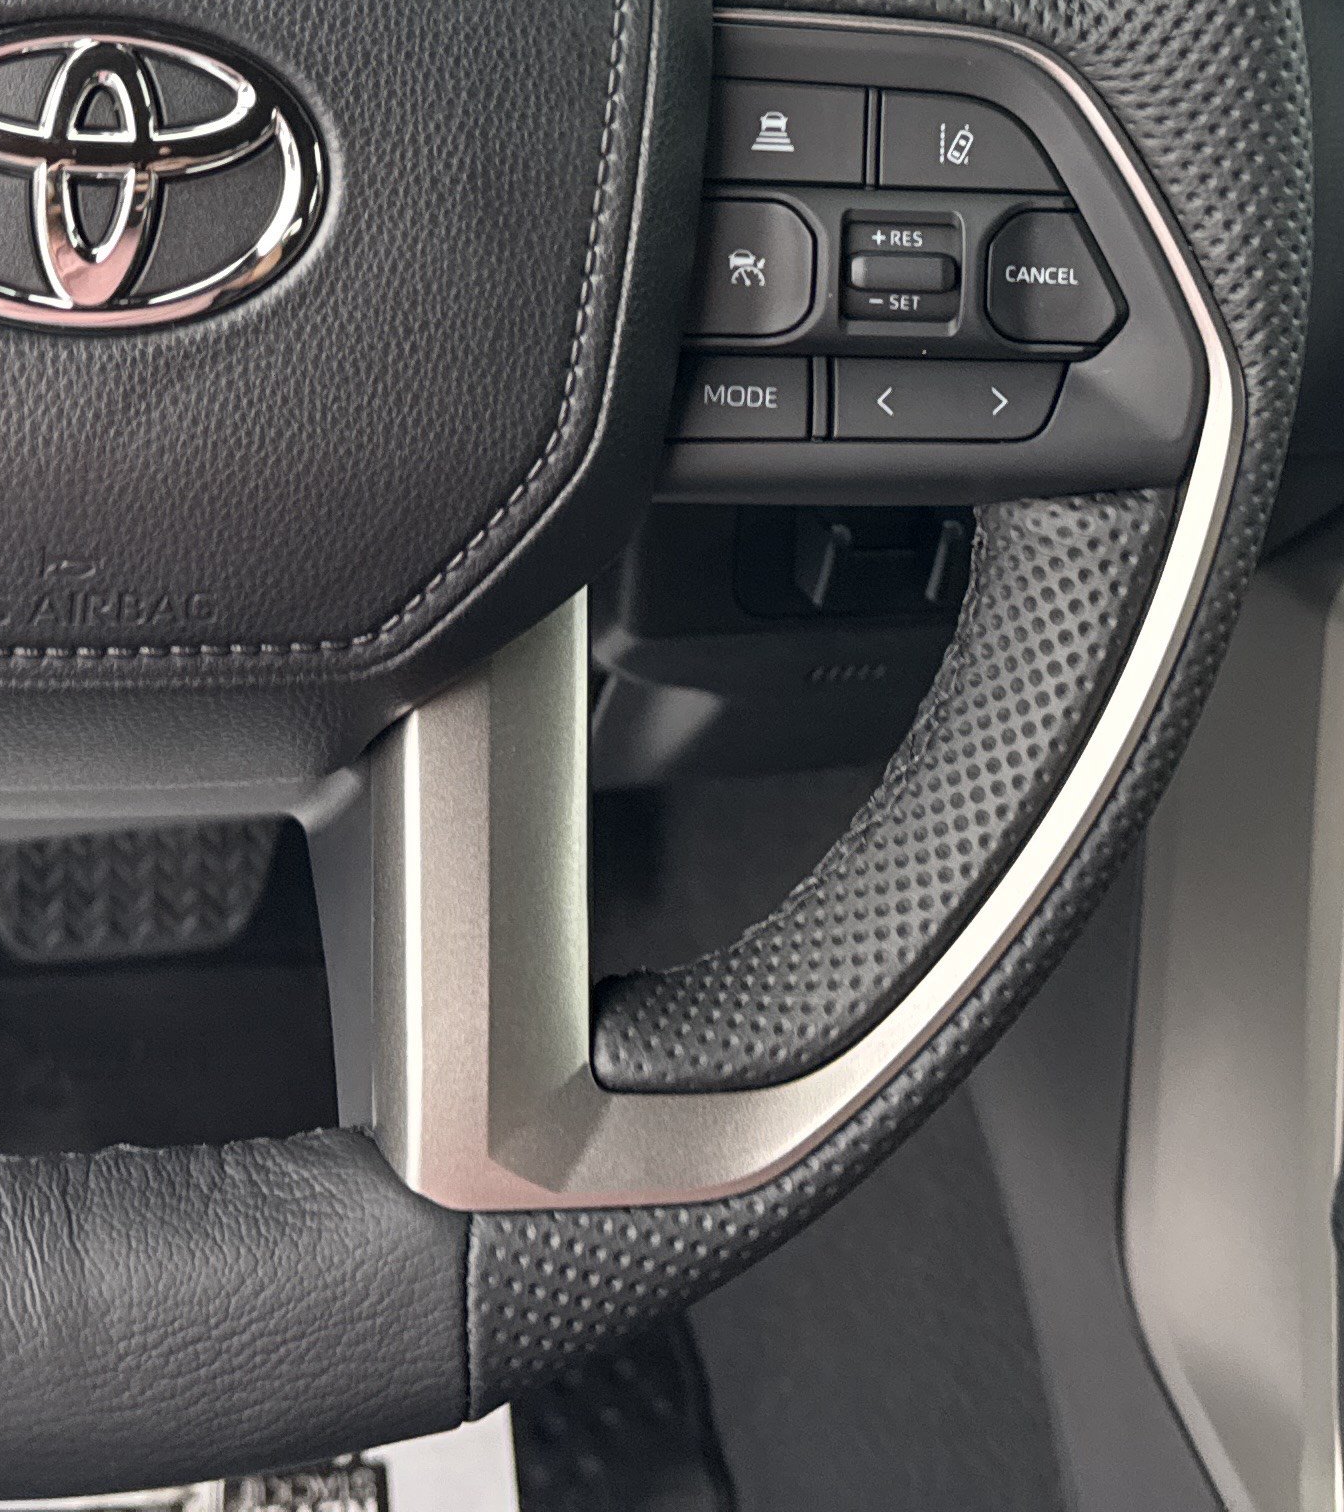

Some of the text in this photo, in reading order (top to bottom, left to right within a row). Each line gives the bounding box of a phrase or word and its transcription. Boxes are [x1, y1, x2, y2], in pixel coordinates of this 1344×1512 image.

[890, 230, 924, 248] RES
[1004, 265, 1079, 285] CANCEL
[888, 294, 922, 311] SET
[702, 384, 778, 409] MODE
[26, 591, 219, 627] AIRBAG
